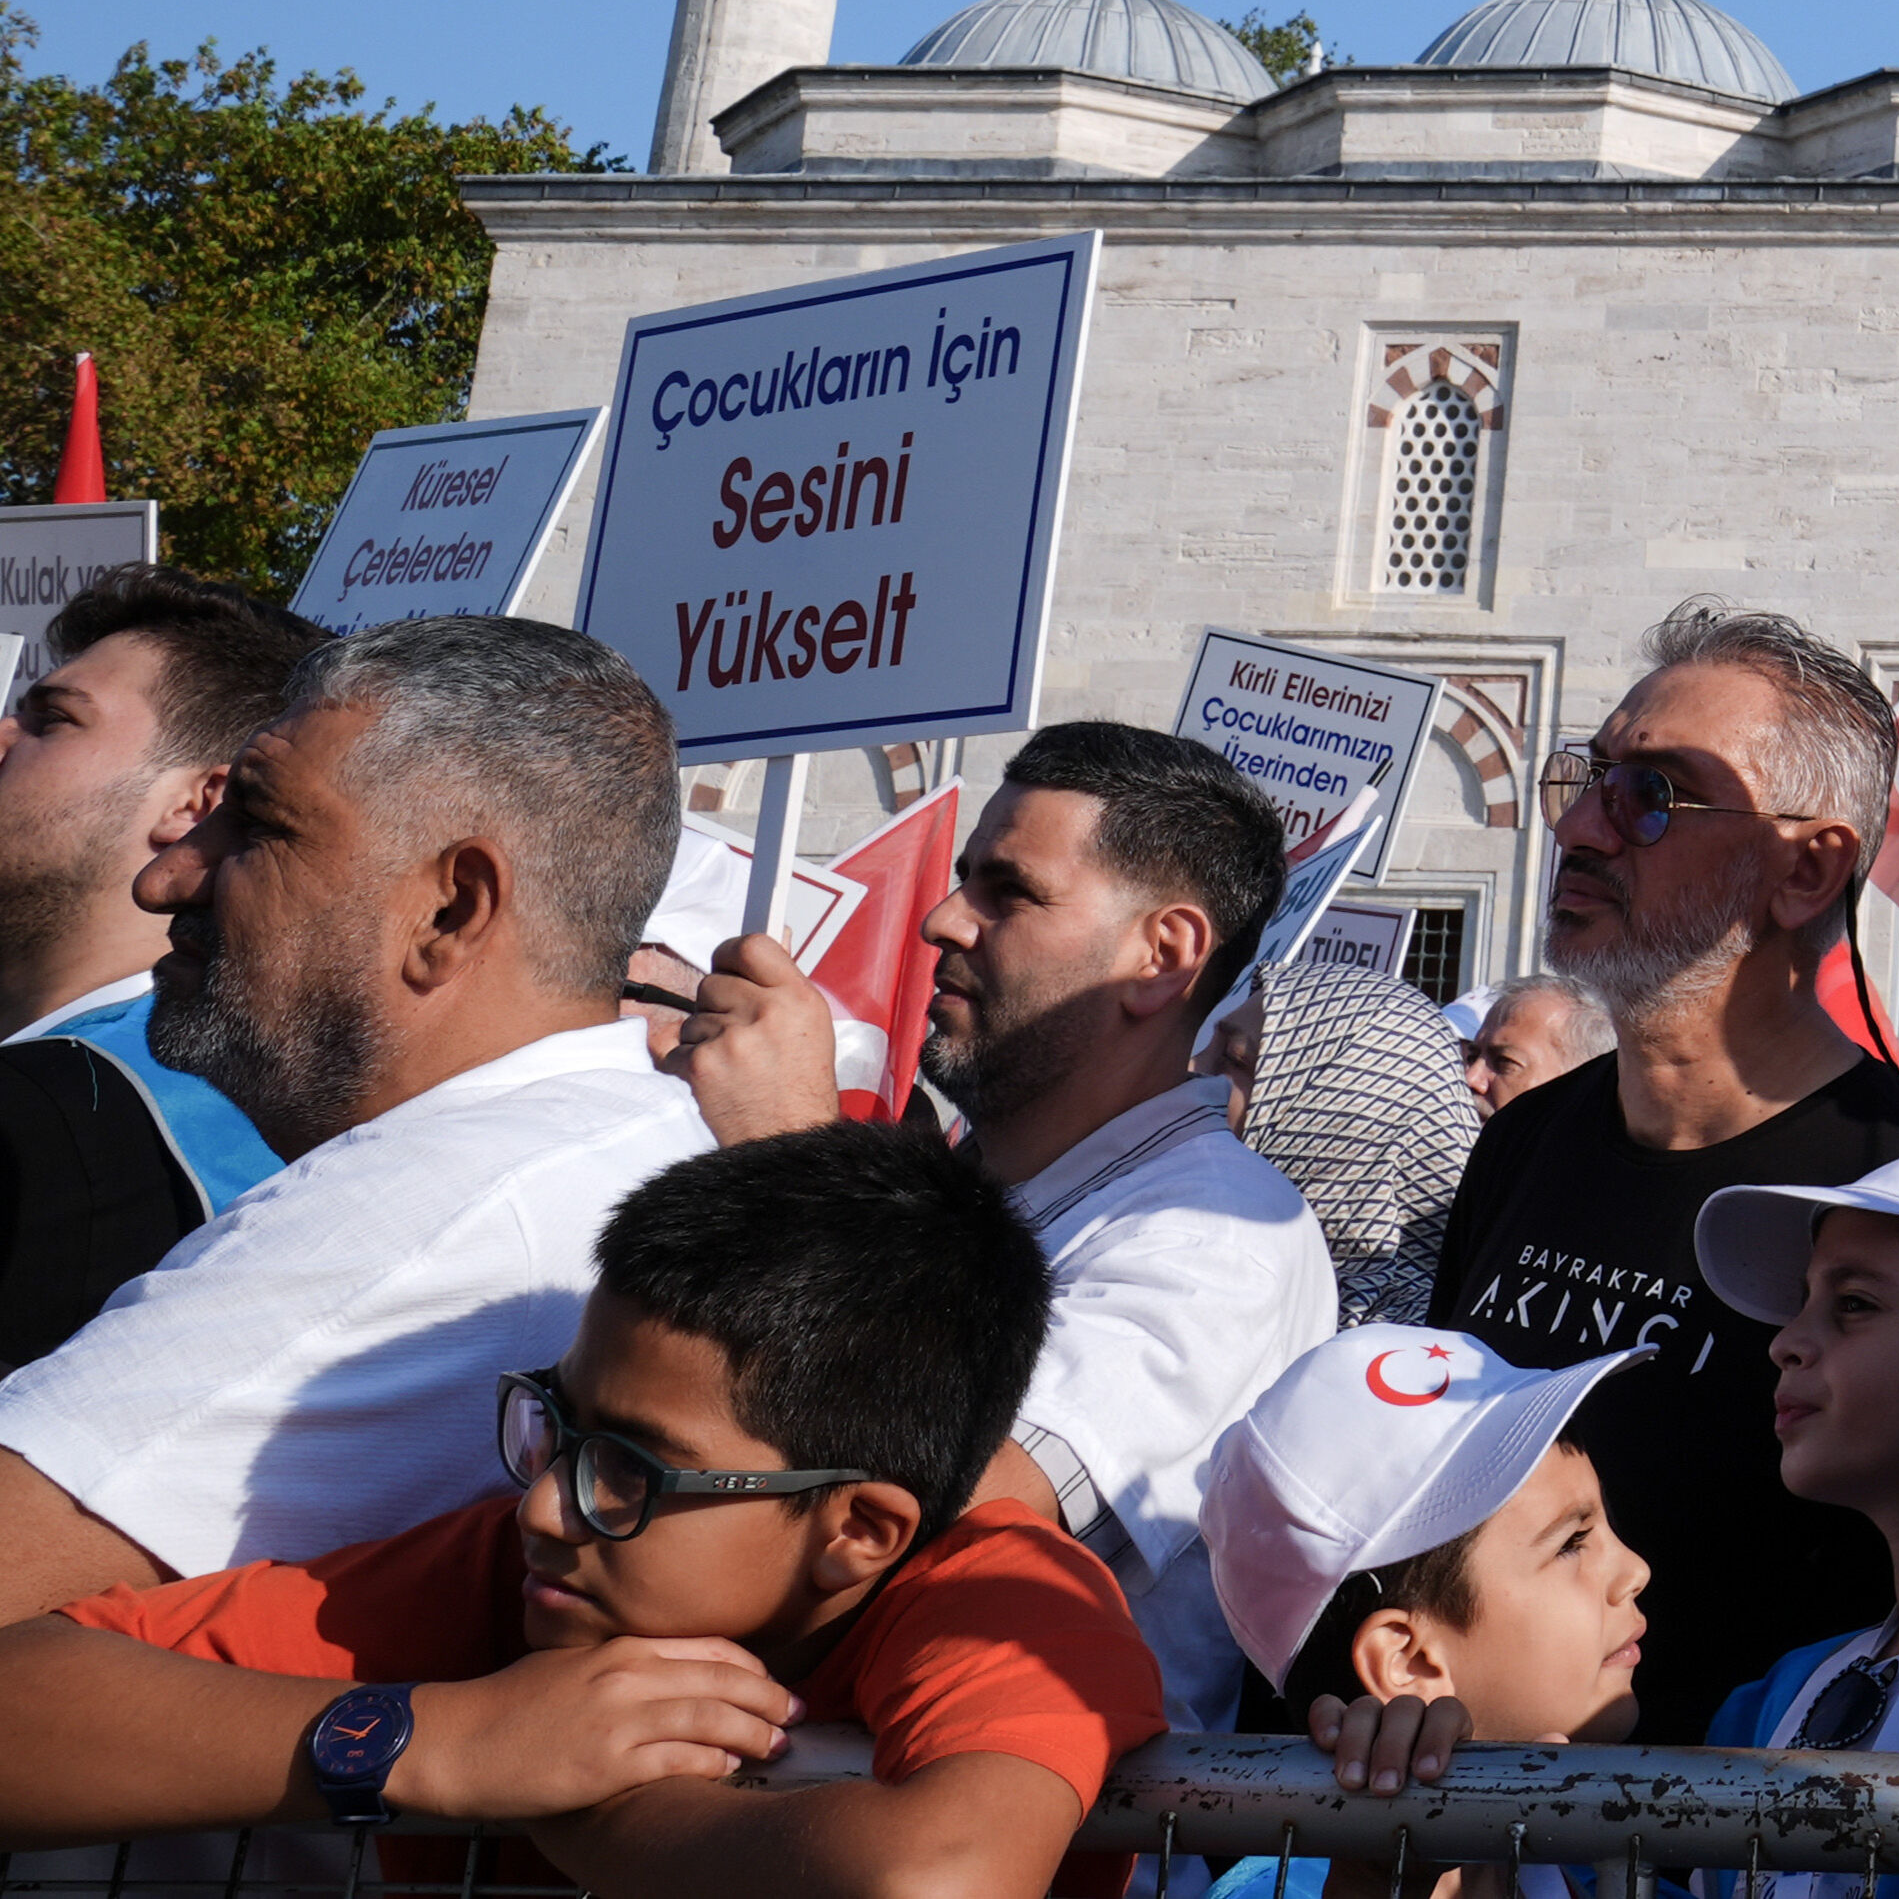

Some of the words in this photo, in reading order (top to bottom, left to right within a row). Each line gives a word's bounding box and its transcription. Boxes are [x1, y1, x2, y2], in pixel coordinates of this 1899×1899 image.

[652, 344, 911, 450] Çocukların
[928, 307, 1022, 405] İçin
[400, 454, 510, 512] Küresel
[711, 431, 914, 550] Sesini
[1, 555, 70, 606] Kulak
[336, 532, 493, 603] Çetelerden
[675, 571, 917, 693] Yükselt
[1228, 659, 1279, 696] Kirli
[1282, 672, 1394, 723] Ellerinizi
[1201, 696, 1394, 764] Çocuklarımızın
[1517, 1244, 1694, 1309] BAYRAKTAR
